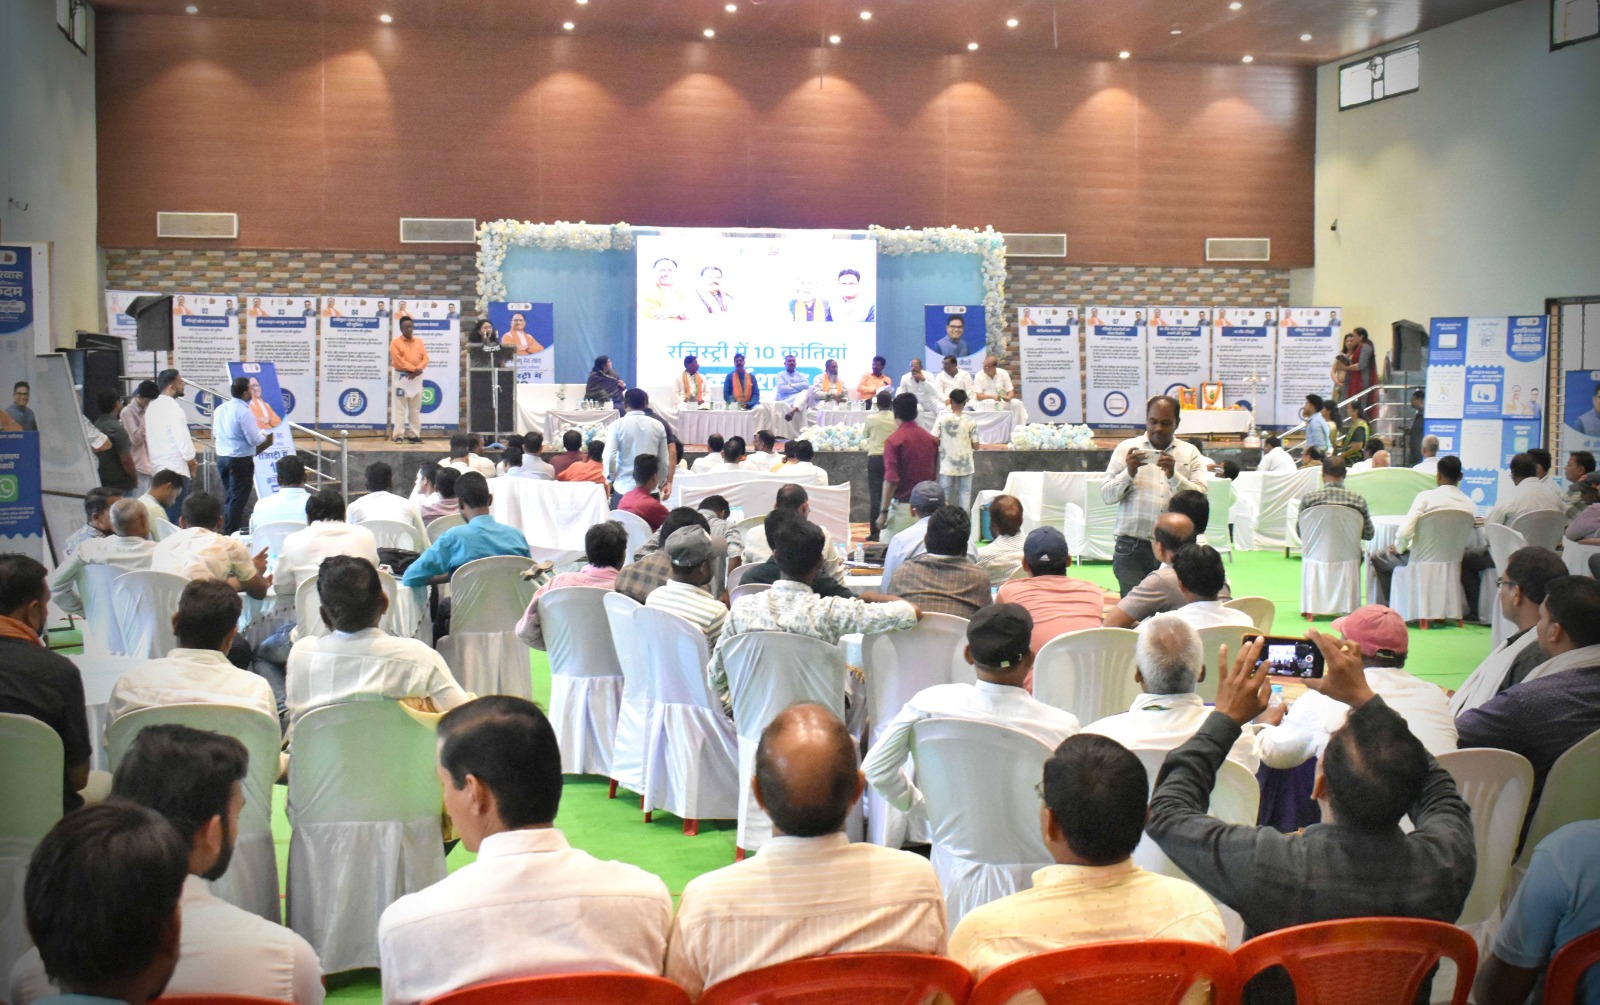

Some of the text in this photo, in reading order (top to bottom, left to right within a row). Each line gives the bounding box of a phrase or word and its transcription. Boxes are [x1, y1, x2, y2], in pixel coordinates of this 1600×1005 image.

[667, 341, 729, 363] रजिस्ट्री
[734, 342, 749, 358] में
[754, 346, 775, 359] 10
